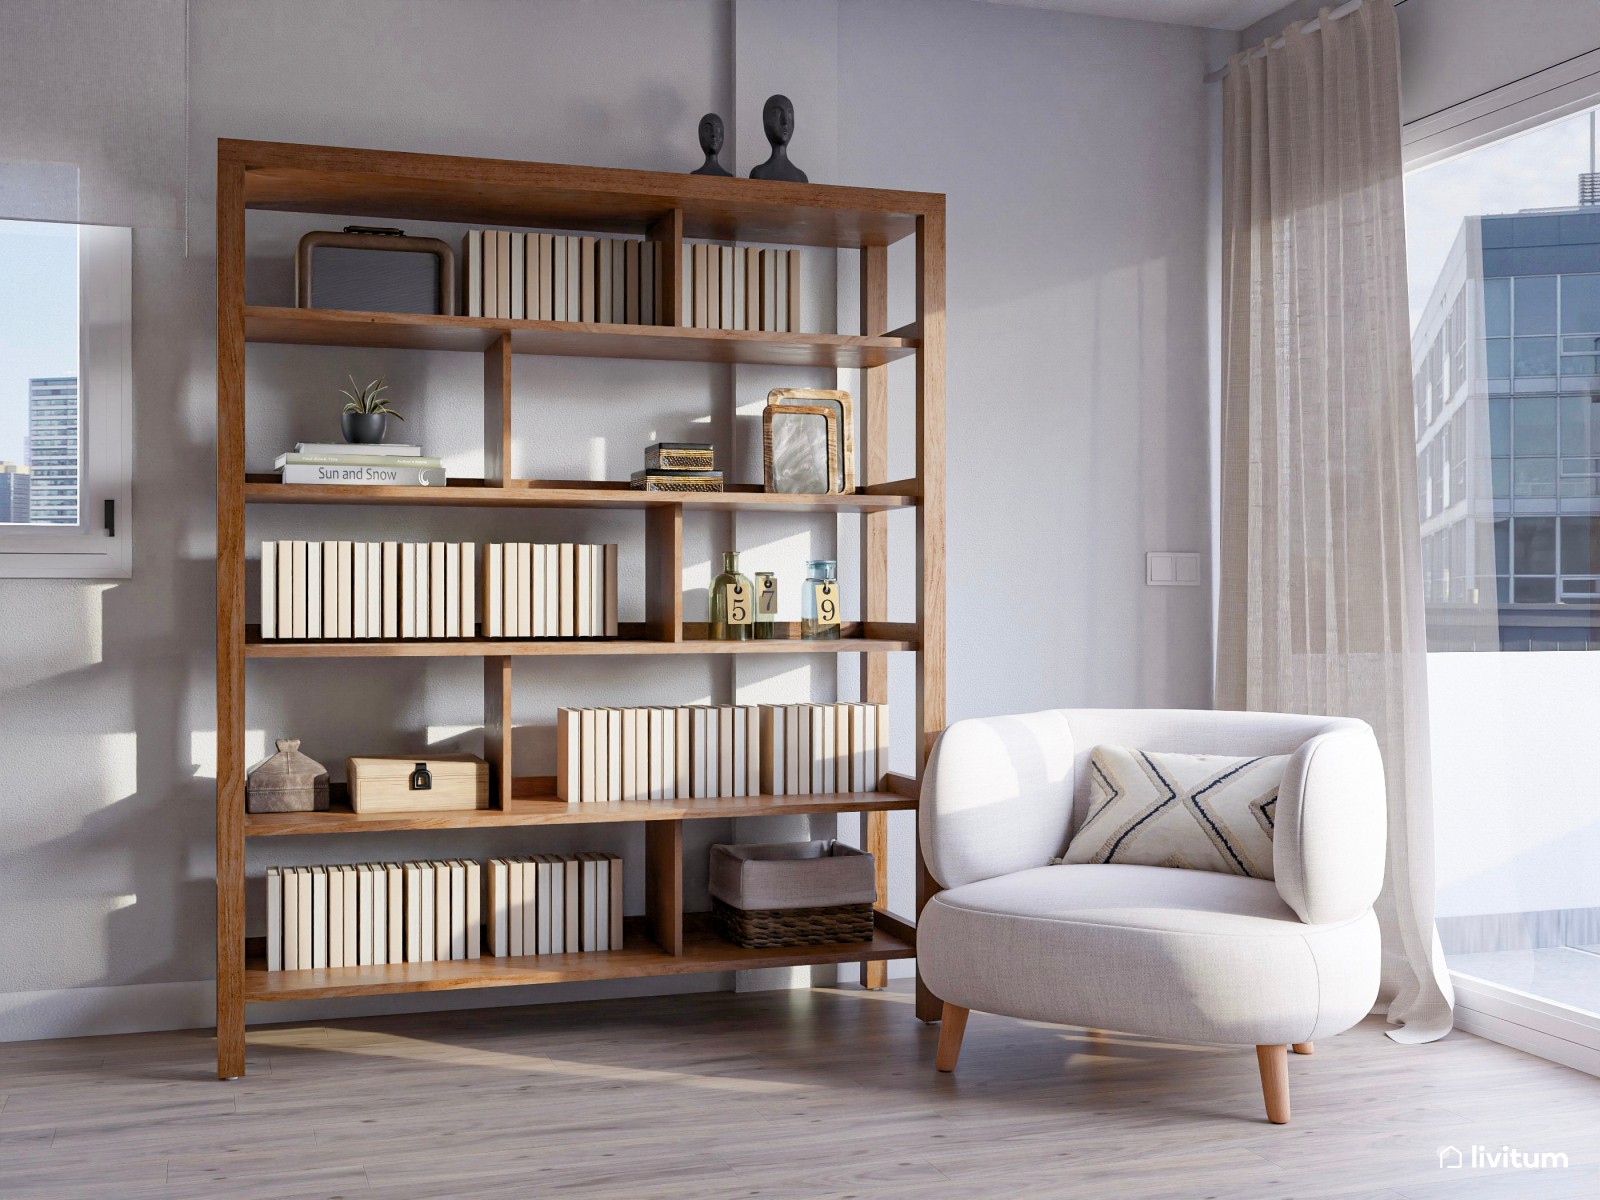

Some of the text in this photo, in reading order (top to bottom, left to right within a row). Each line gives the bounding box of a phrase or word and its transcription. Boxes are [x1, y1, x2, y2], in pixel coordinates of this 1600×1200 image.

[318, 466, 397, 481] Sun and Snow
[732, 598, 746, 622] 5
[761, 590, 775, 612] 7
[820, 598, 835, 622] 9
